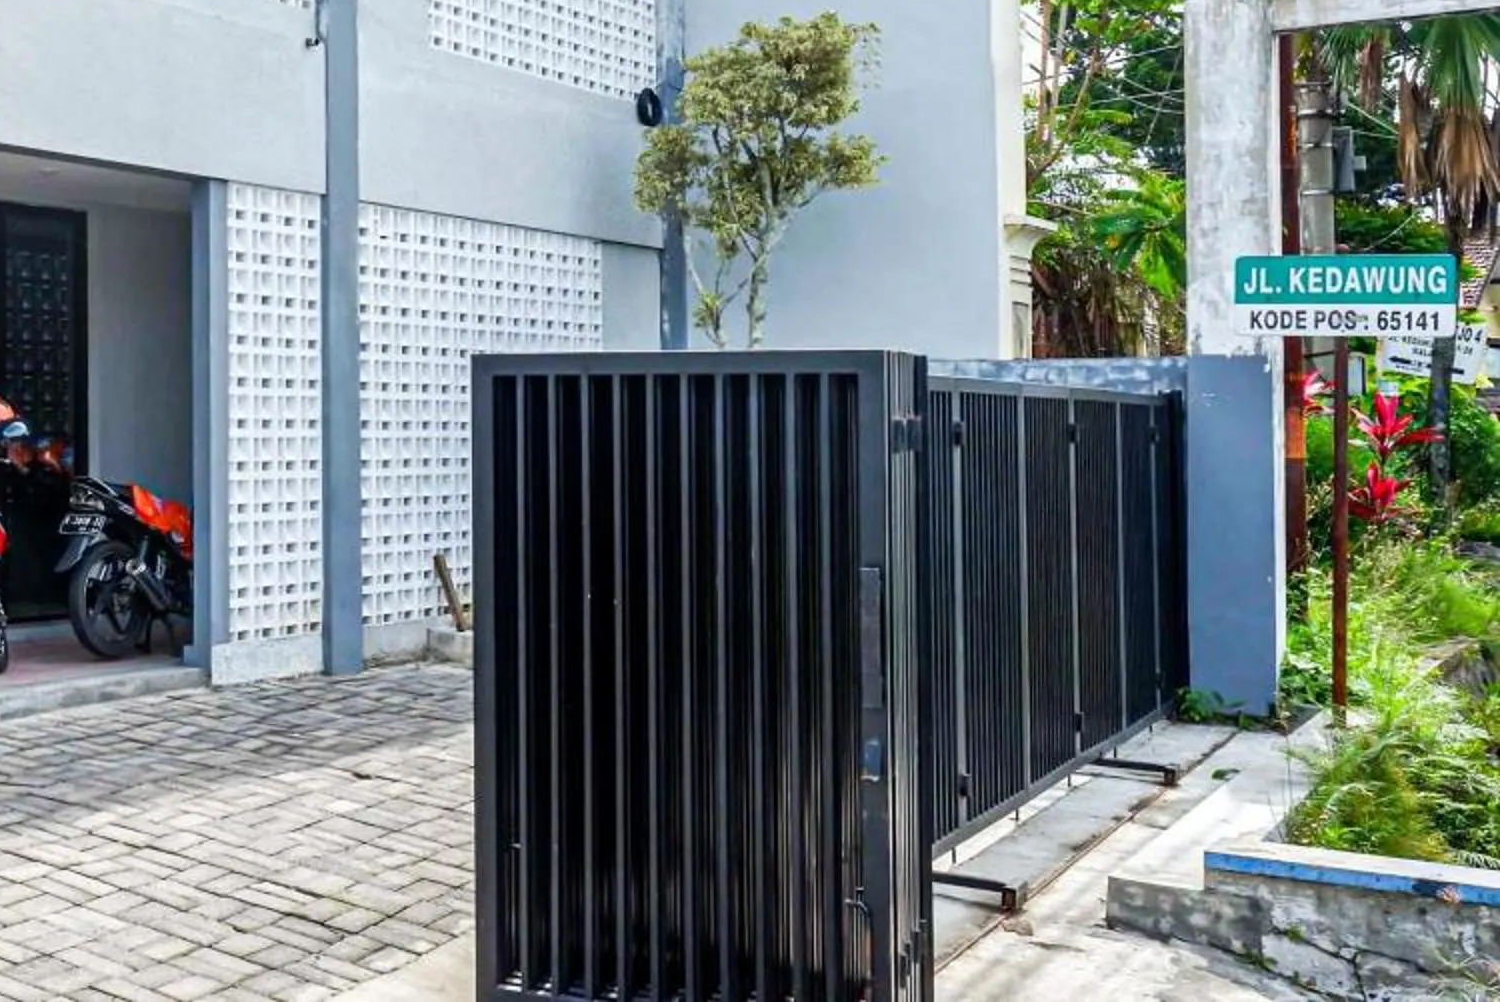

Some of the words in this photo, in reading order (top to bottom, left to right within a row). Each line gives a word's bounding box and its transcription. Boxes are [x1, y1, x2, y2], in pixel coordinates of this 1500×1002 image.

[1243, 266, 1281, 294] JL.
[1288, 265, 1448, 294] KEDAWUNG
[1250, 310, 1307, 331] KODE
[1314, 310, 1357, 331] POS
[1377, 310, 1440, 331] 65141
